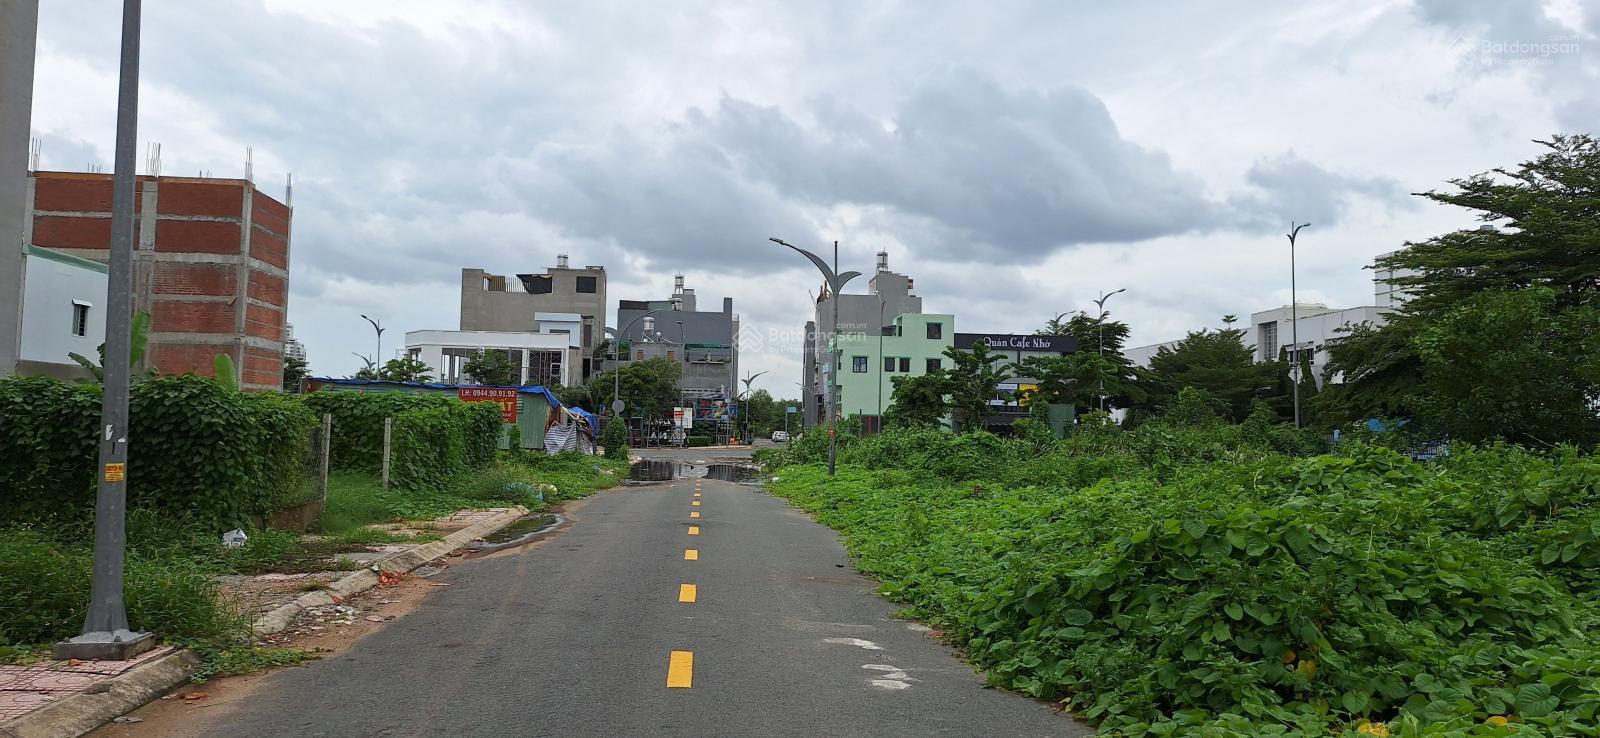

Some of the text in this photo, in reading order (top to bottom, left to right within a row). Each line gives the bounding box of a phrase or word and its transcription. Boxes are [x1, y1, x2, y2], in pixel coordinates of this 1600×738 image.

[984, 336, 1007, 347] Quán
[1010, 336, 1030, 348] Cafe
[473, 389, 515, 397] 0944.90.91.92
